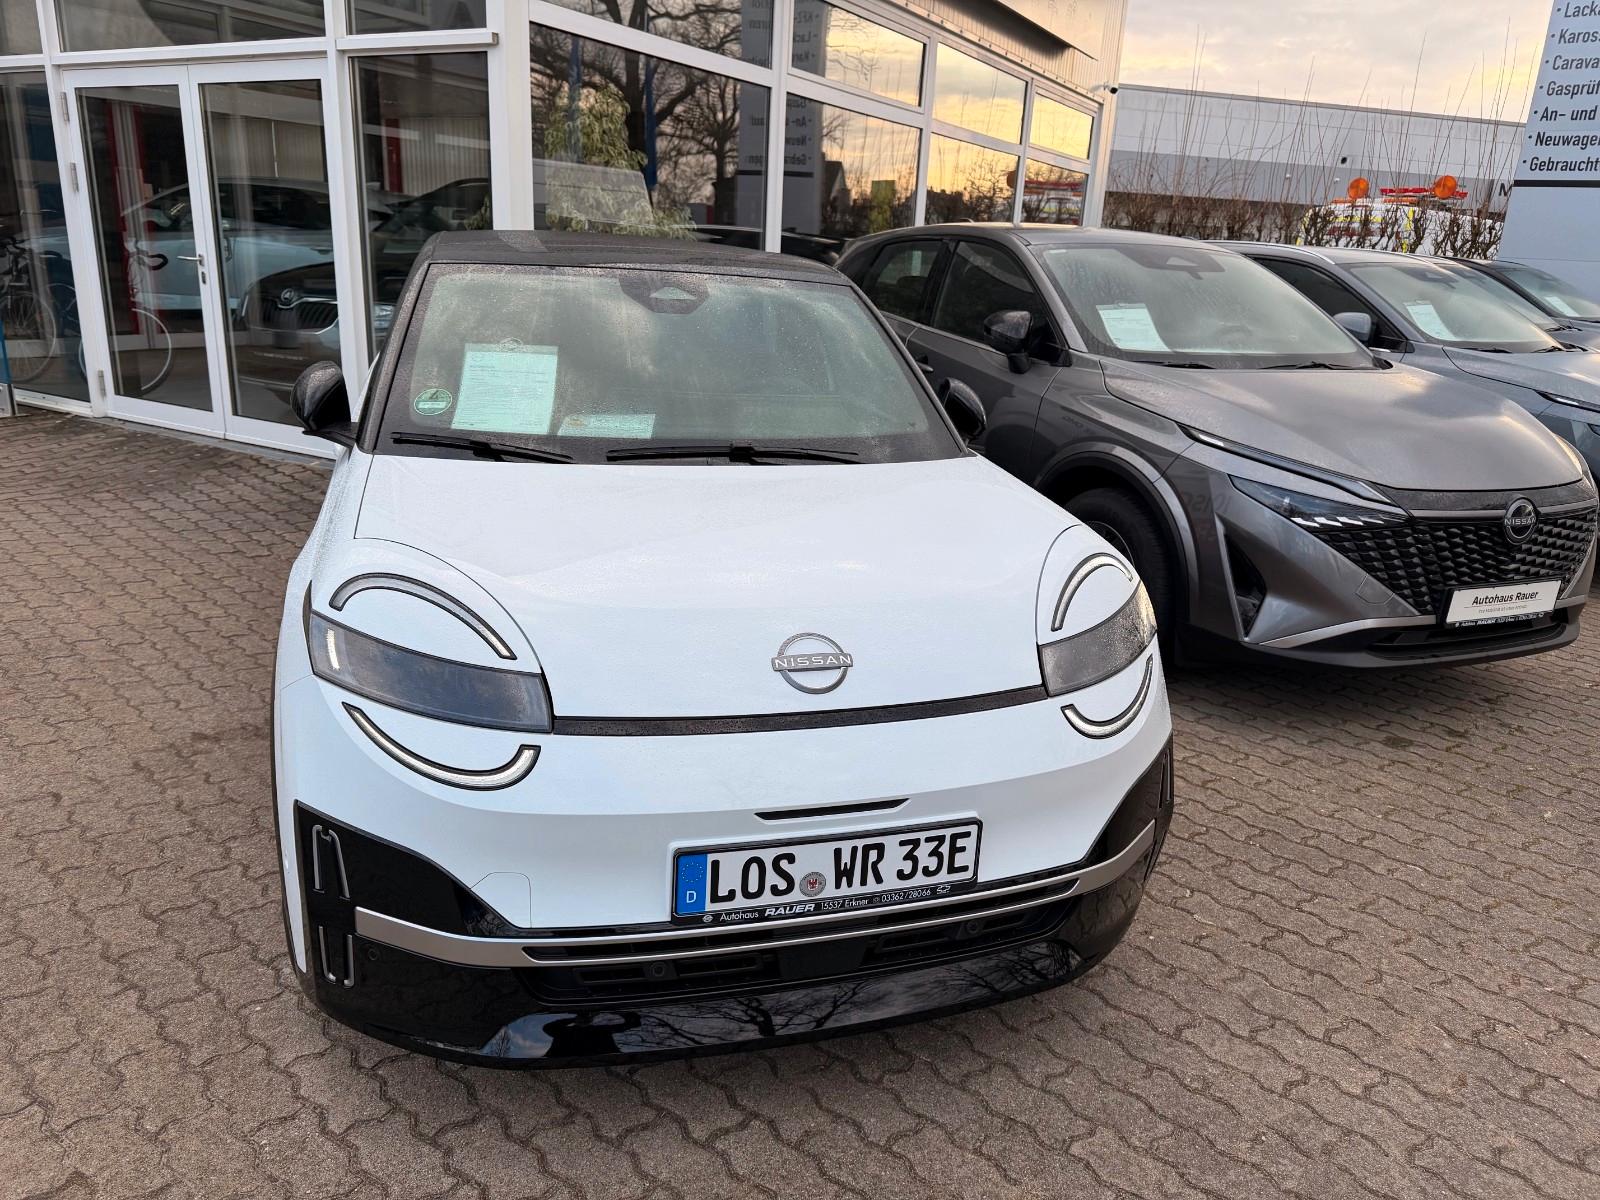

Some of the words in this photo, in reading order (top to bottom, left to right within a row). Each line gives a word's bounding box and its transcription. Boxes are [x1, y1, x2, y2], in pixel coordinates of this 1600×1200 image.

[1558, 28, 1600, 44] Karos
[1540, 105, 1566, 121] An-
[1570, 105, 1598, 121] und
[1504, 517, 1537, 526] NISSAN
[1472, 594, 1514, 606] Autohaus
[1515, 591, 1539, 601] Rauer
[774, 655, 852, 669] NISSAN
[709, 852, 796, 904] LOS
[833, 842, 886, 890] WR
[896, 830, 972, 881] 33E
[686, 890, 697, 904] D
[719, 911, 759, 922] Autohaus
[765, 903, 816, 917] RAUER
[820, 901, 842, 910] 15537
[845, 899, 868, 908] Erkner
